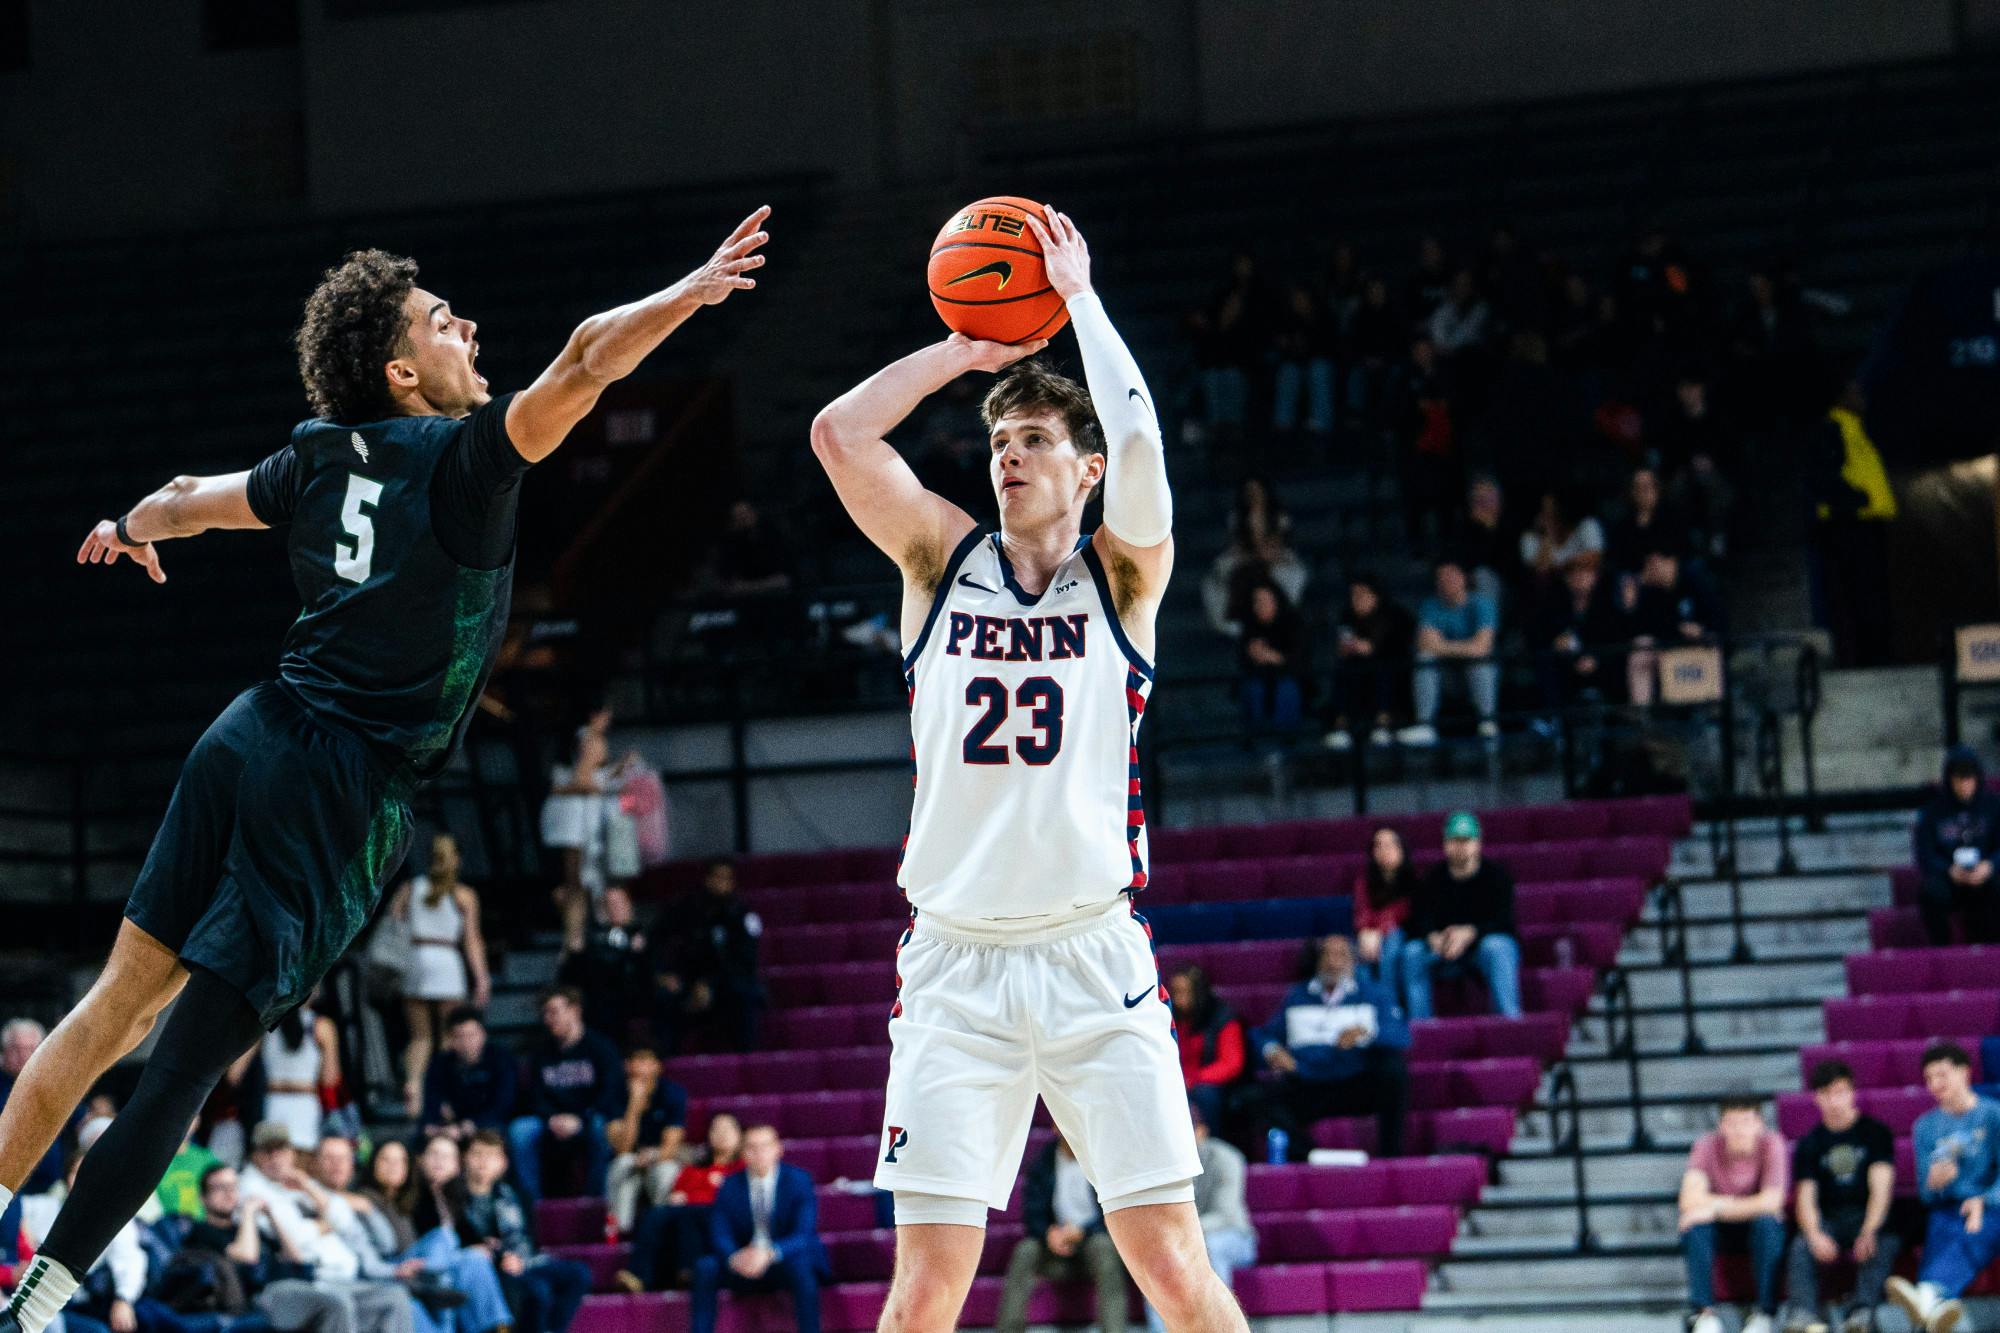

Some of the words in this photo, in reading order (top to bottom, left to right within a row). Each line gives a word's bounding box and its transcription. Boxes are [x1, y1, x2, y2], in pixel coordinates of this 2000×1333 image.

[334, 472, 384, 585] 5
[1055, 583, 1070, 595] Ivy
[946, 611, 1089, 662] PENN
[963, 676, 1064, 766] 23
[884, 1125, 909, 1164] P
